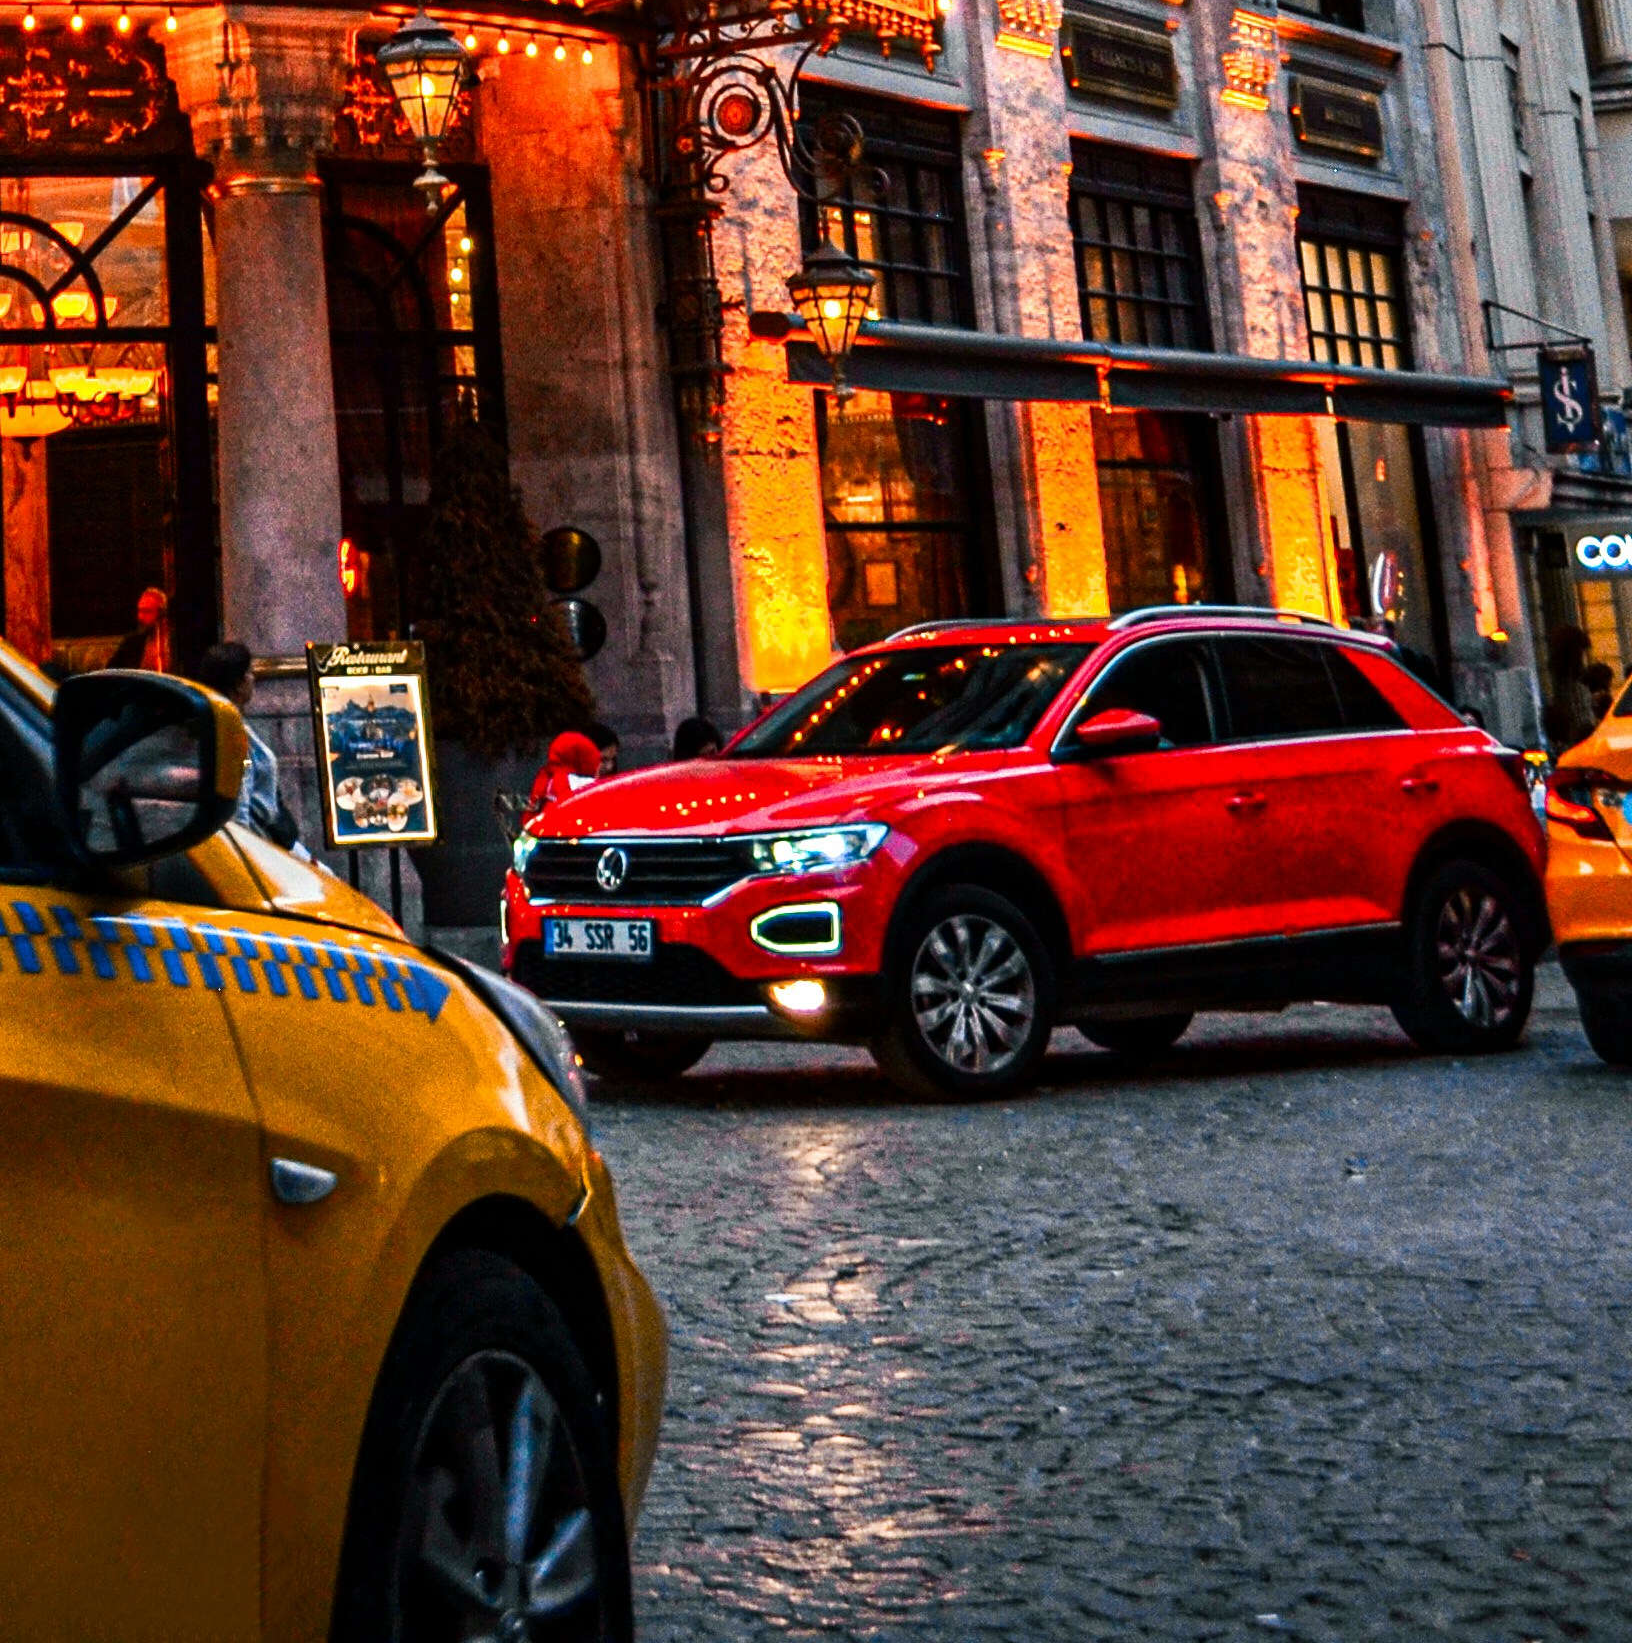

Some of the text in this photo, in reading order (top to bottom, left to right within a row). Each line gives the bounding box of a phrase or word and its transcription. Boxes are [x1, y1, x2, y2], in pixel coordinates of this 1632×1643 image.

[1575, 533, 1632, 571] CO
[327, 645, 408, 666] Restaurant
[554, 921, 649, 952] 34 SSR 56
